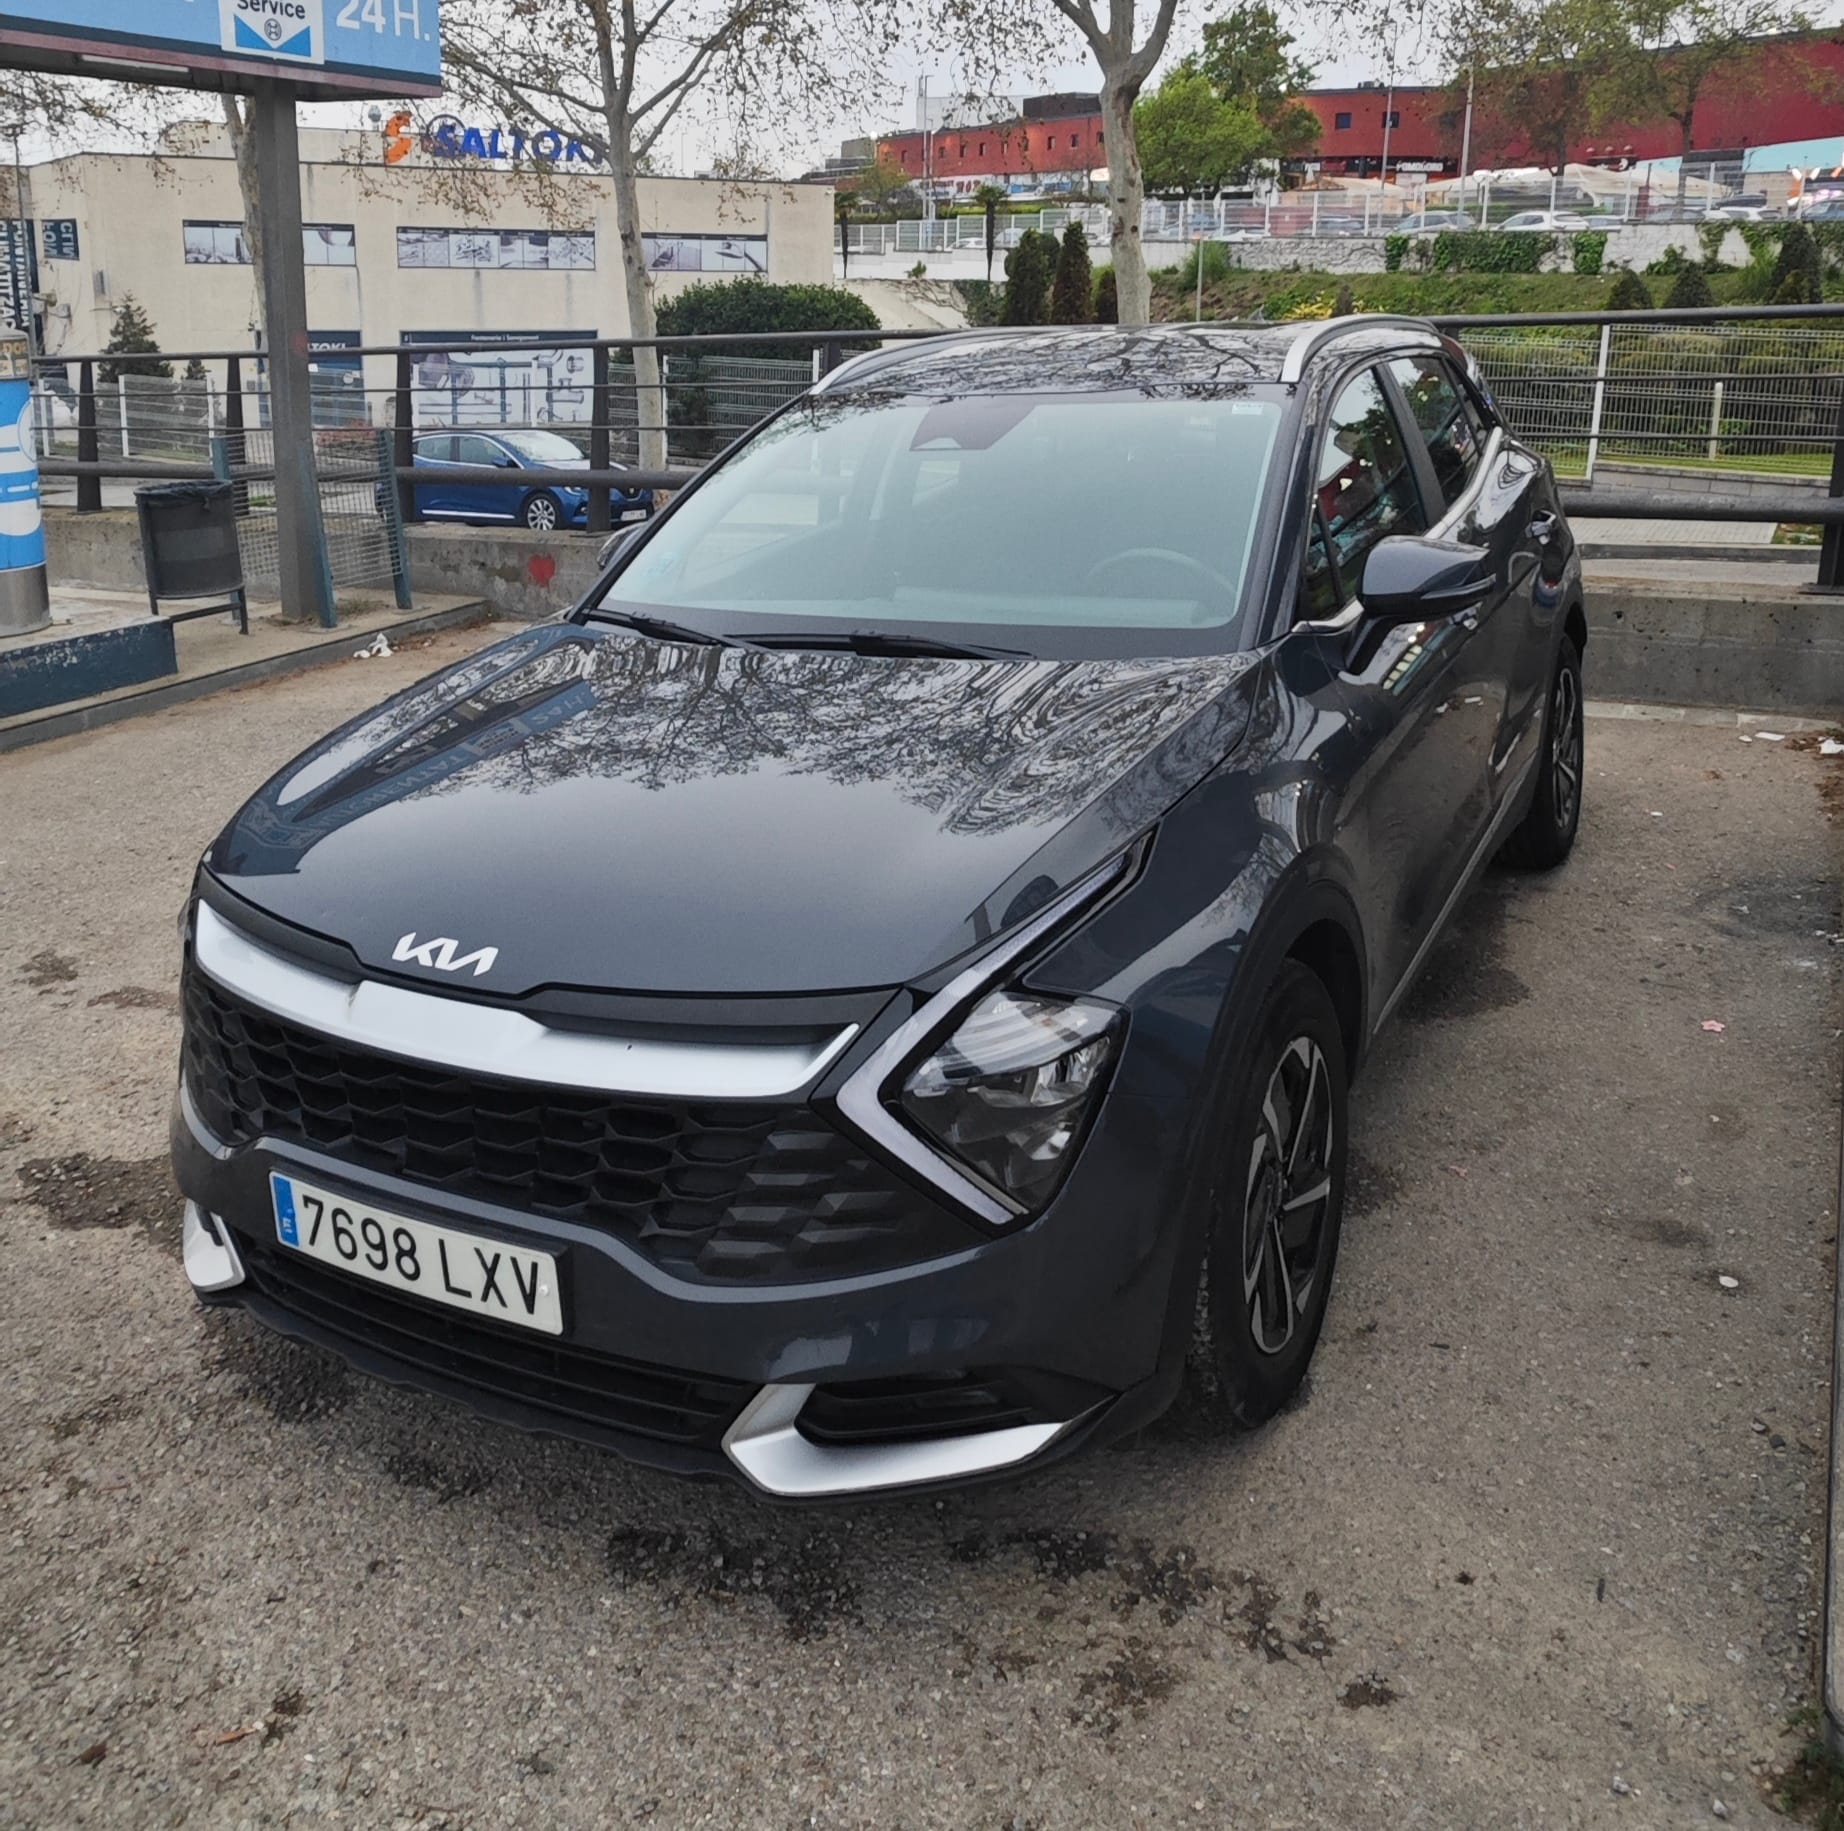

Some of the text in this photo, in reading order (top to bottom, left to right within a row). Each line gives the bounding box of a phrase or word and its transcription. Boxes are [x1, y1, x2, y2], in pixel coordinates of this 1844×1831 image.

[237, 0, 306, 20] Service
[432, 124, 603, 165] SALTOK
[303, 1195, 539, 1315] 7698 LXV
